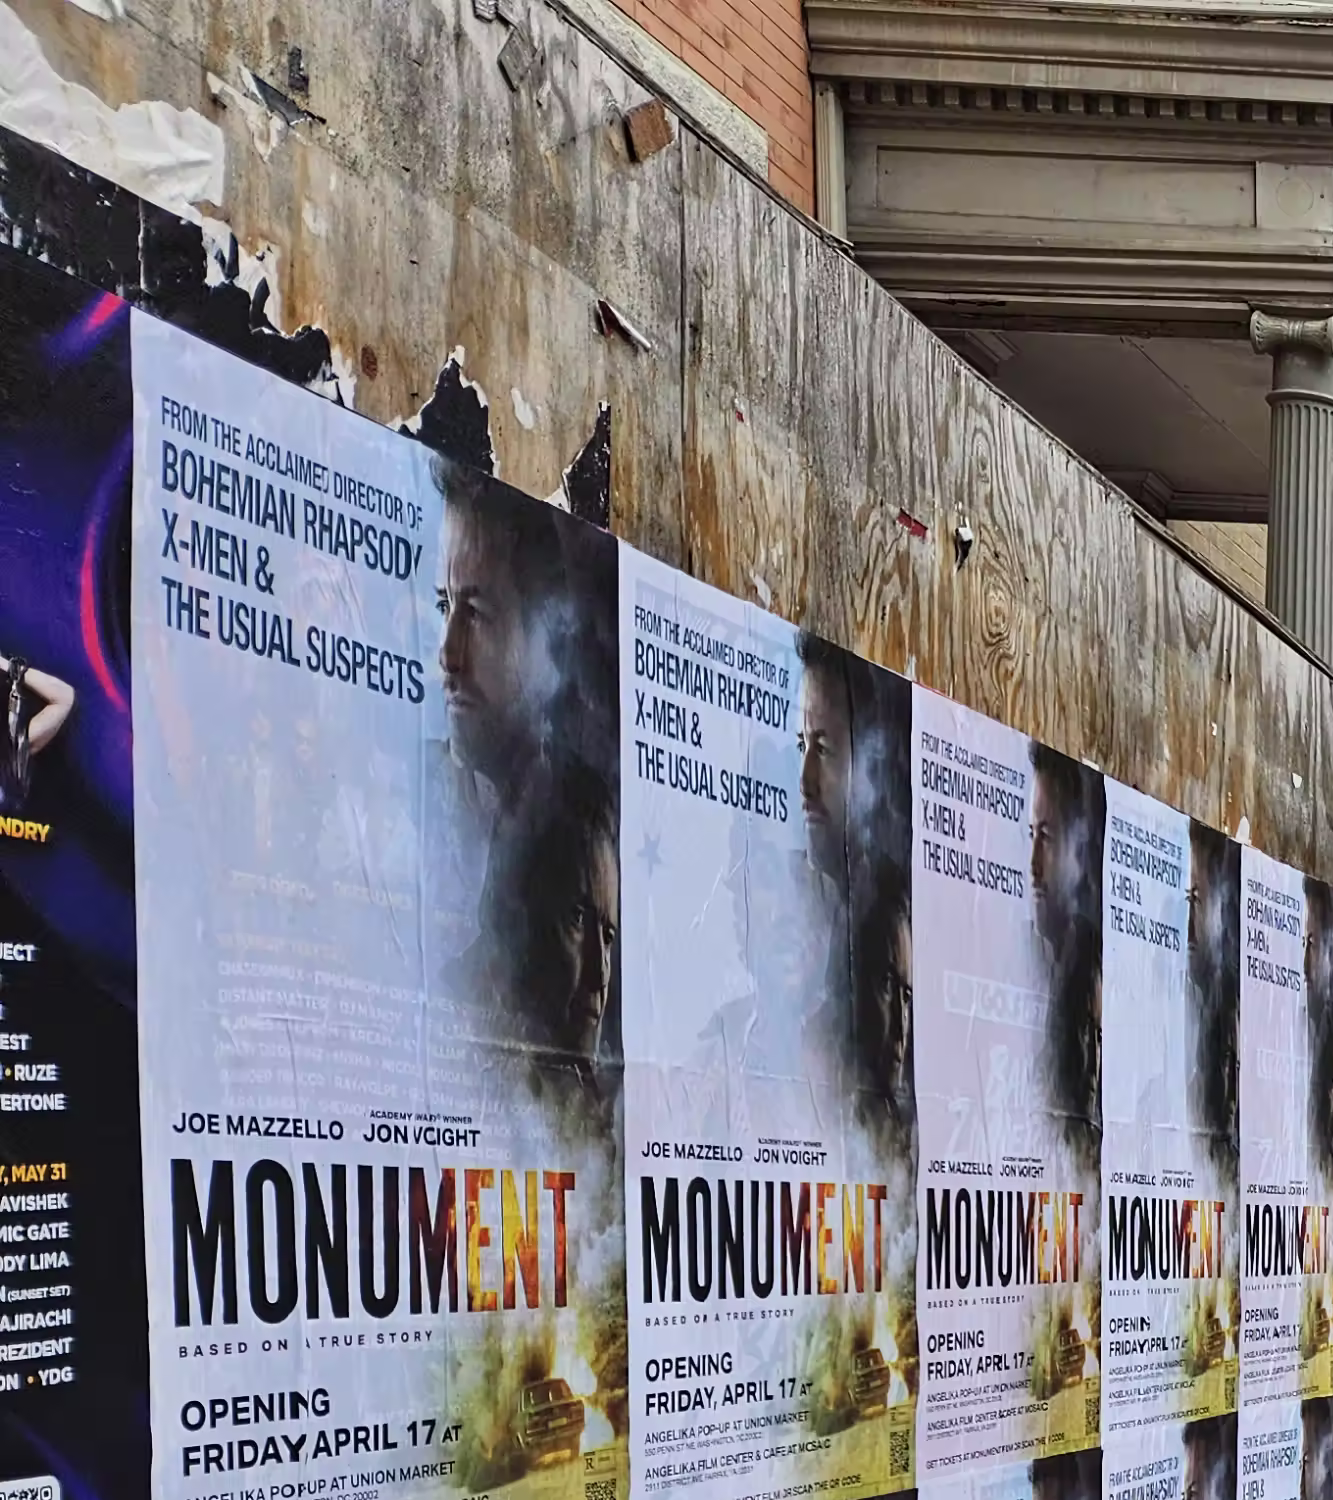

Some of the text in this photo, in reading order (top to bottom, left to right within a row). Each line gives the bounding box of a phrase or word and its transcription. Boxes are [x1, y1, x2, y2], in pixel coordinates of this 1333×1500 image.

[161, 396, 423, 531] FROM THE ACCLAIMED DIRECTOR OF
[162, 440, 423, 581] BOHEMIAN RHAPSODY
[161, 508, 275, 595] X-MEN &
[161, 576, 424, 704] THE USUAL SUSPECTS
[635, 639, 790, 732] BOHEMIAN RHAPSODY
[635, 689, 703, 748] X-MEN &
[635, 740, 788, 822] THE USUAL SUSPECTS
[921, 798, 956, 839] X-MEN
[942, 850, 1024, 900] USUAL SUSPECTS
[14, 1063, 59, 1081] RUZE
[173, 1112, 344, 1141] JOE MAZZELLO
[369, 1109, 473, 1125] ACADEMY WINNER
[363, 1123, 410, 1145] JON
[641, 1141, 743, 1162] JOE MAZZELLO
[753, 1149, 827, 1166] JON VOIGHT
[12, 1162, 67, 1182] MAY 31
[1, 1192, 69, 1212] AVISHEK
[27, 1222, 70, 1241] GATE
[170, 1158, 575, 1328] MONUMENT
[640, 1176, 888, 1304] MONUMENT
[926, 1187, 1084, 1290] MONUMENT
[1109, 1195, 1225, 1281] MONUMENT
[1245, 1204, 1329, 1278] MONUMENT
[30, 1251, 70, 1270] LIMA
[8, 1285, 70, 1301] (SUNSET SET)
[1244, 1307, 1279, 1324] OPENING
[179, 1330, 434, 1358] BASED ON TRUE STORY
[927, 1330, 984, 1354] OPENING
[38, 1367, 73, 1386] YDG
[645, 1351, 733, 1382] OPENING
[927, 1352, 1025, 1381] FRIDAY, APRIL 17
[180, 1388, 331, 1431] OPENING
[645, 1378, 813, 1416] FRIDAY, APRIL 17 AT
[312, 1425, 398, 1459] APRIL
[406, 1419, 437, 1448] 17
[441, 1424, 463, 1444] AT
[644, 1426, 696, 1445] ANGELIKA
[330, 1477, 347, 1492] AT
[350, 1469, 397, 1490] UNION
[399, 1461, 456, 1483] MARKET
